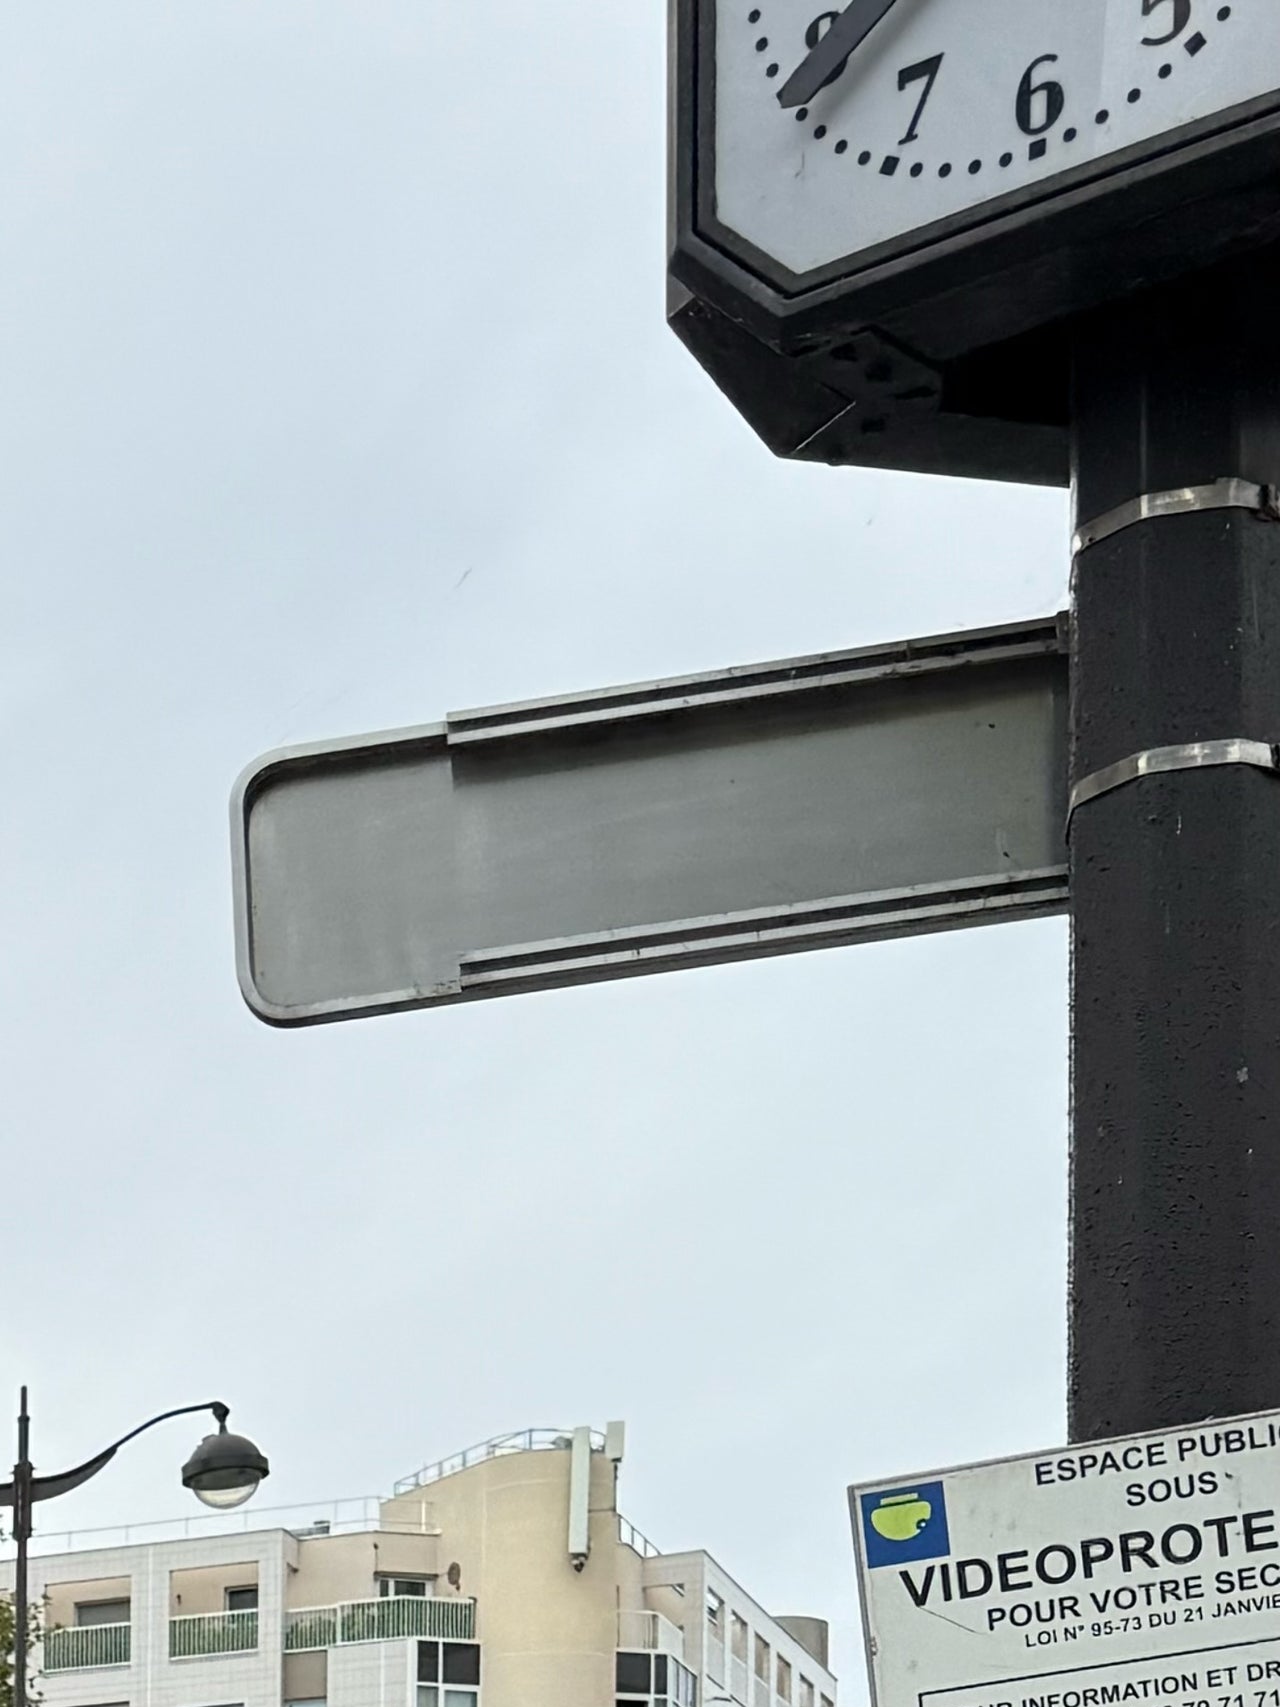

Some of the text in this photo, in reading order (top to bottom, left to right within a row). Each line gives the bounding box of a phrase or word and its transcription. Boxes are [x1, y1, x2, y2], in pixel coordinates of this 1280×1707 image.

[897, 52, 944, 145] 7
[1015, 54, 1065, 135] 6
[1035, 1424, 1280, 1485] ESPACE PUBLI
[1126, 1471, 1219, 1506] SOUS
[899, 1510, 1279, 1607] VIDEOPROTE
[987, 1563, 1280, 1631] POUR VOTRE SEC
[1025, 1629, 1058, 1648] LOI
[1091, 1616, 1141, 1637] 95-73
[1149, 1610, 1177, 1628] DU
[1183, 1606, 1204, 1623] 21
[1206, 1666, 1238, 1689] ET
